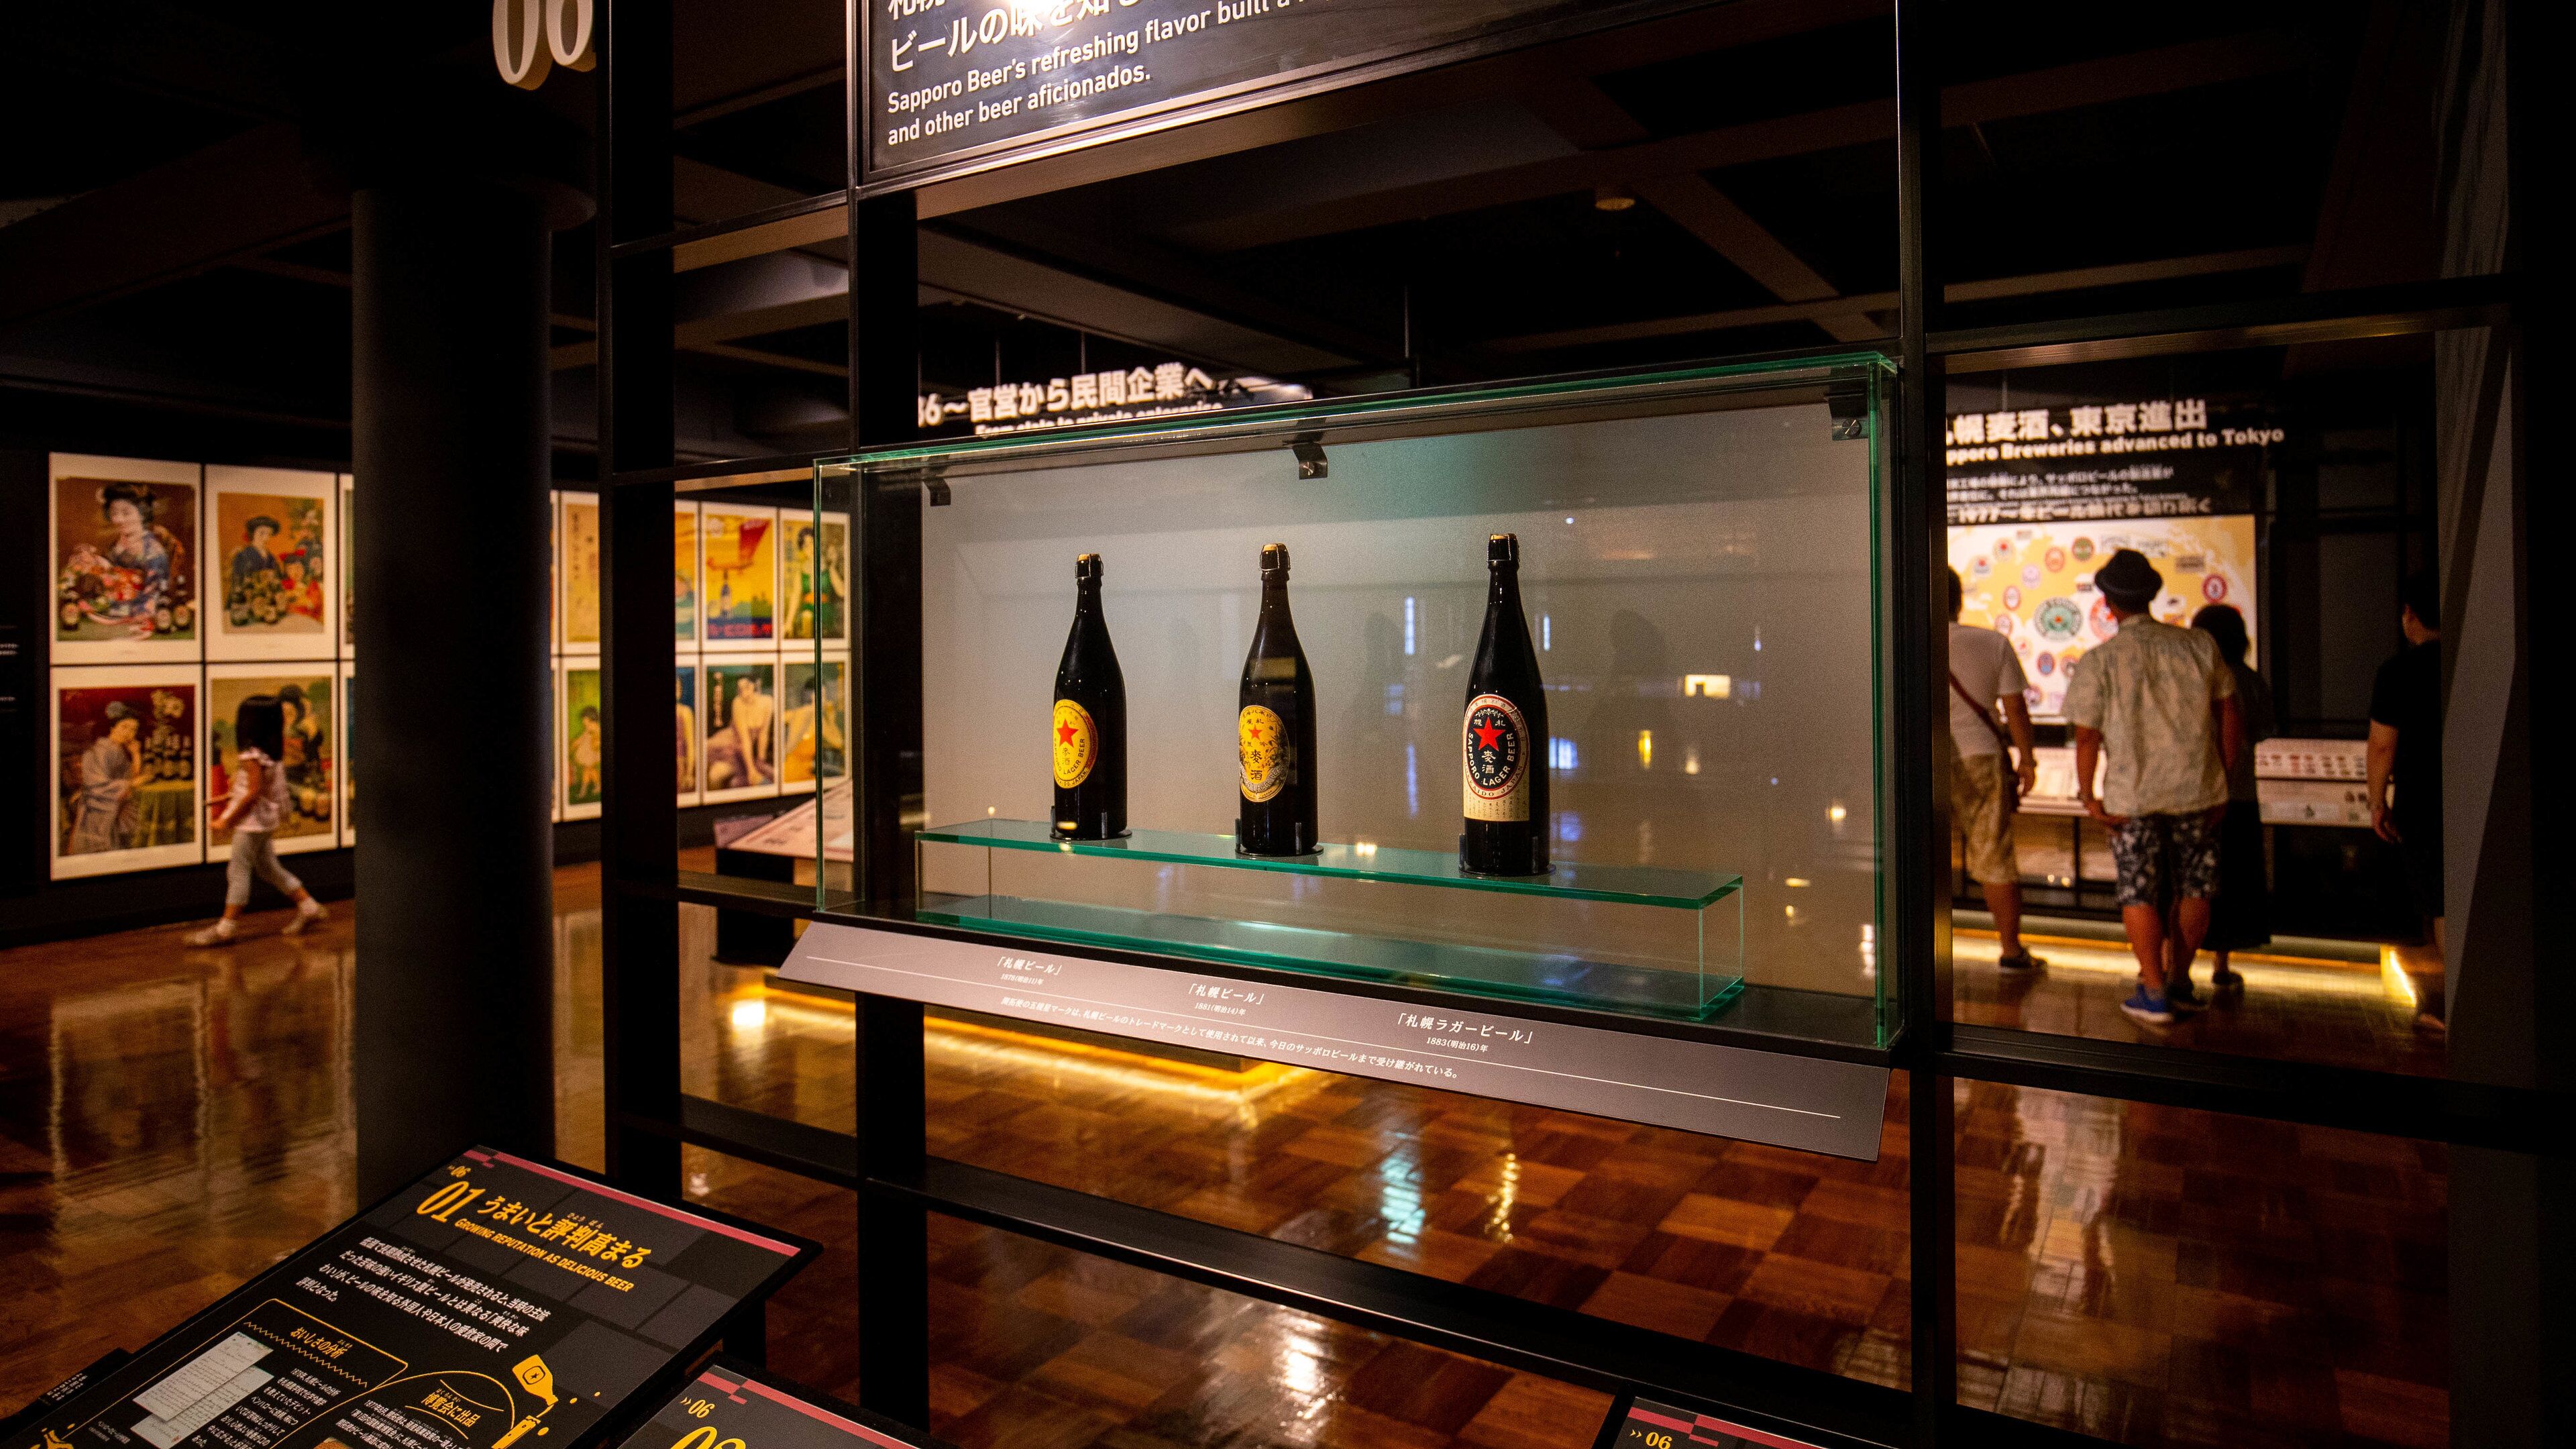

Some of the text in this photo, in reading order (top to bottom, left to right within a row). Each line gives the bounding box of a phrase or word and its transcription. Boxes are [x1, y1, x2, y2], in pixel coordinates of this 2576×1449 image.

[892, 0, 1139, 72] ビールの味を知
[888, 78, 962, 113] Sapporo
[967, 58, 1026, 93] Beer's
[1031, 31, 1138, 74] refreshing
[1145, 9, 1211, 44] flavor
[888, 65, 1151, 146] and other beer aficionados.
[1947, 398, 2208, 447] 幌麦酒、東京進出
[2100, 431, 2193, 453] advanced
[2196, 430, 2218, 448] to
[2222, 425, 2285, 447] Tokyo
[1063, 760, 1081, 775] LAGER
[1468, 733, 1480, 780] SAPPORO
[1483, 765, 1511, 786] LAGER
[1507, 733, 1515, 762] BEER
[1501, 766, 1523, 794] JAPAN
[997, 955, 1063, 976] 「札幌ビール」
[1189, 983, 1265, 1006] 「札幌ビール」
[1397, 1012, 1534, 1044] 「札幌ラガービール」
[450, 1165, 471, 1179] 06
[417, 1181, 486, 1224] 01
[477, 1195, 652, 1269] うまいと評判高まる
[454, 1218, 635, 1293] GROWING REPUTATION AS DELICIOUS BEER
[289, 1327, 347, 1360] おいしさの分析
[421, 1393, 482, 1428] 博覧会に出品
[688, 1399, 715, 1419] 06
[1645, 1431, 1674, 1449] 06
